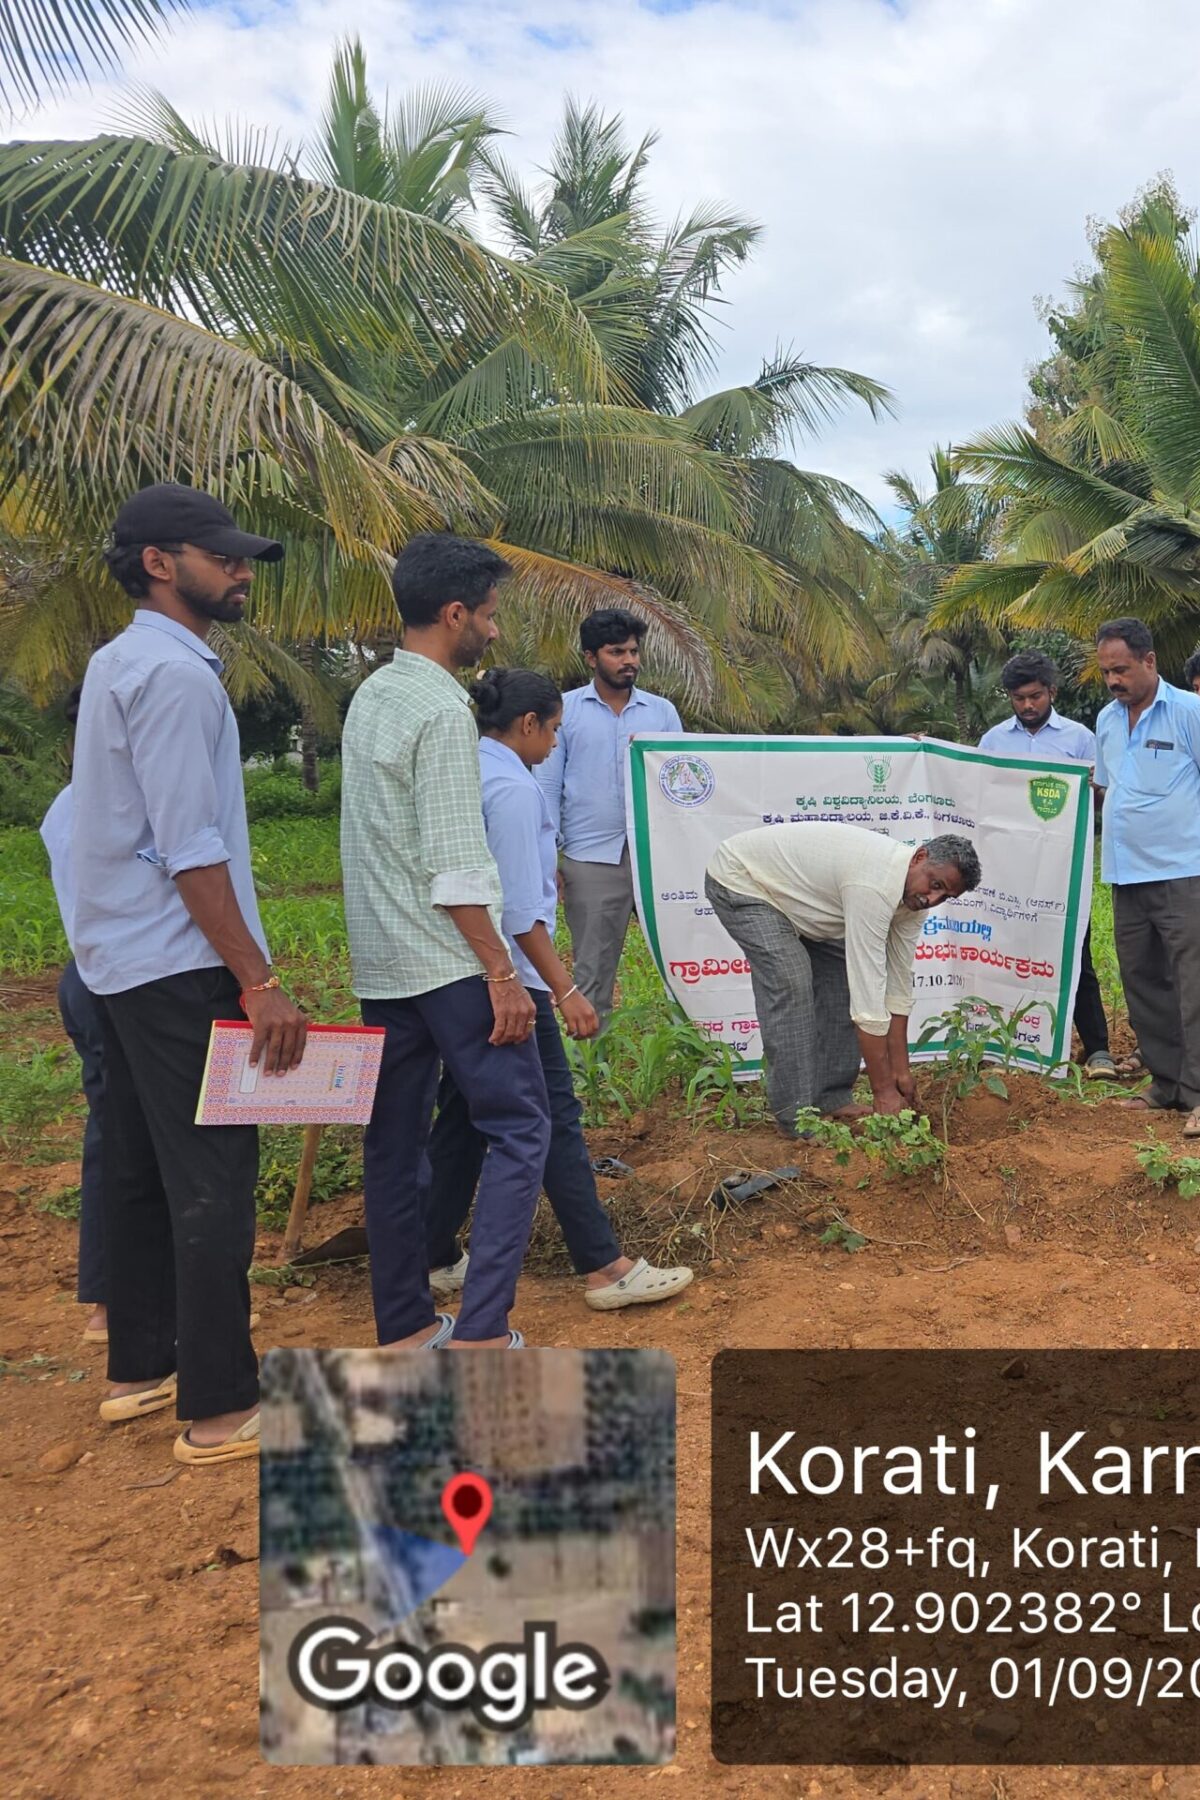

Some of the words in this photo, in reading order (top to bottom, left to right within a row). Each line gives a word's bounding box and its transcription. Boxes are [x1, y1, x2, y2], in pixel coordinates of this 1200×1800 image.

[1036, 787, 1060, 799] KSDA
[796, 795, 817, 811] ಕೃಷಿ
[960, 946, 1055, 980] ಕಾರ್ಯಕ್ರಮ
